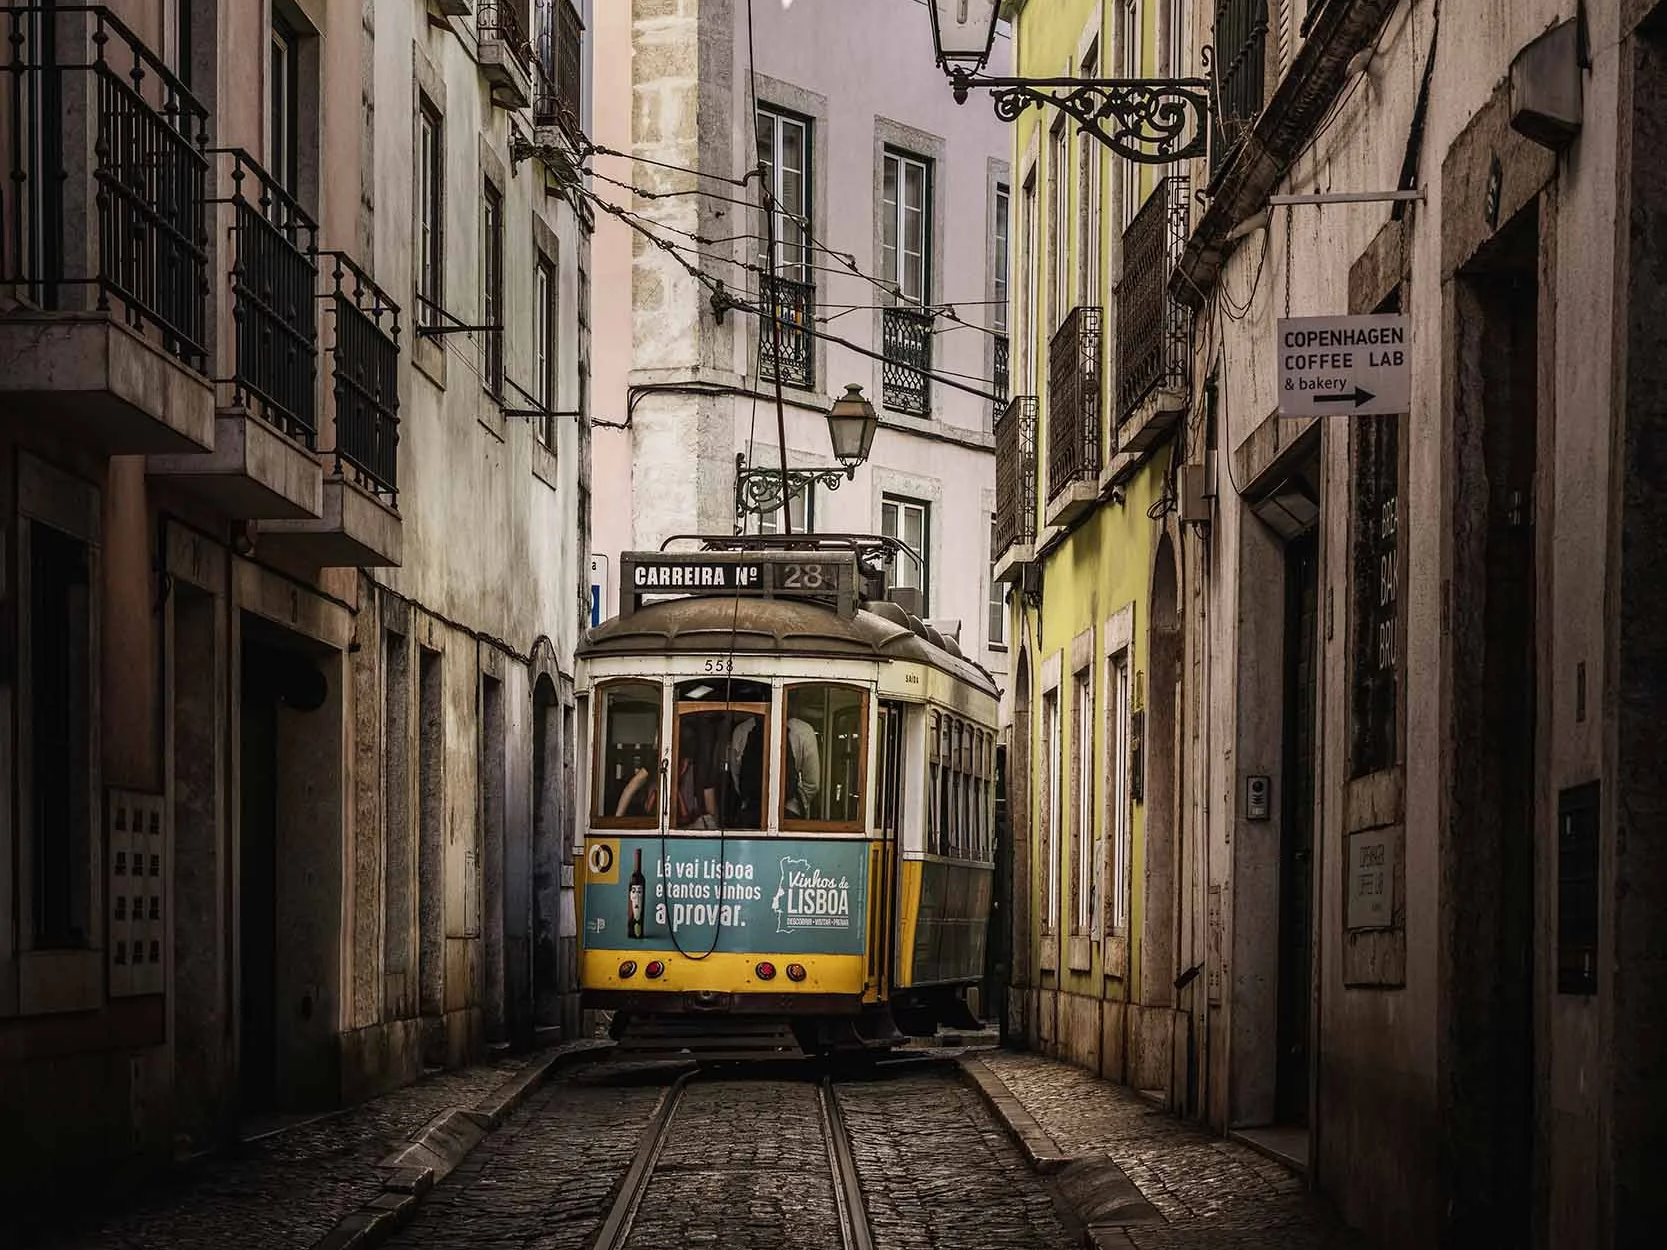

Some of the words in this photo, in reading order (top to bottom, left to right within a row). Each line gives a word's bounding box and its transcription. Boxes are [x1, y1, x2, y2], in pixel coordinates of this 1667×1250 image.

[1284, 327, 1404, 348] COPENHAGEN
[1285, 353, 1353, 370] COFFEE
[1369, 351, 1404, 367] LAB
[1284, 377, 1295, 391] &
[1299, 376, 1347, 392] bakery
[634, 566, 725, 586] CARREIRA
[735, 566, 758, 586] Nº
[784, 564, 823, 588] 28
[705, 659, 733, 672] 558
[676, 859, 699, 879] vai
[703, 859, 754, 880] Lisboa
[788, 869, 838, 889] Vinhos
[656, 883, 663, 898] e
[667, 882, 710, 899] tantos
[714, 882, 761, 900] vinhos
[787, 889, 849, 915] LISBOA
[656, 903, 667, 925] a
[673, 903, 746, 933] provar.
